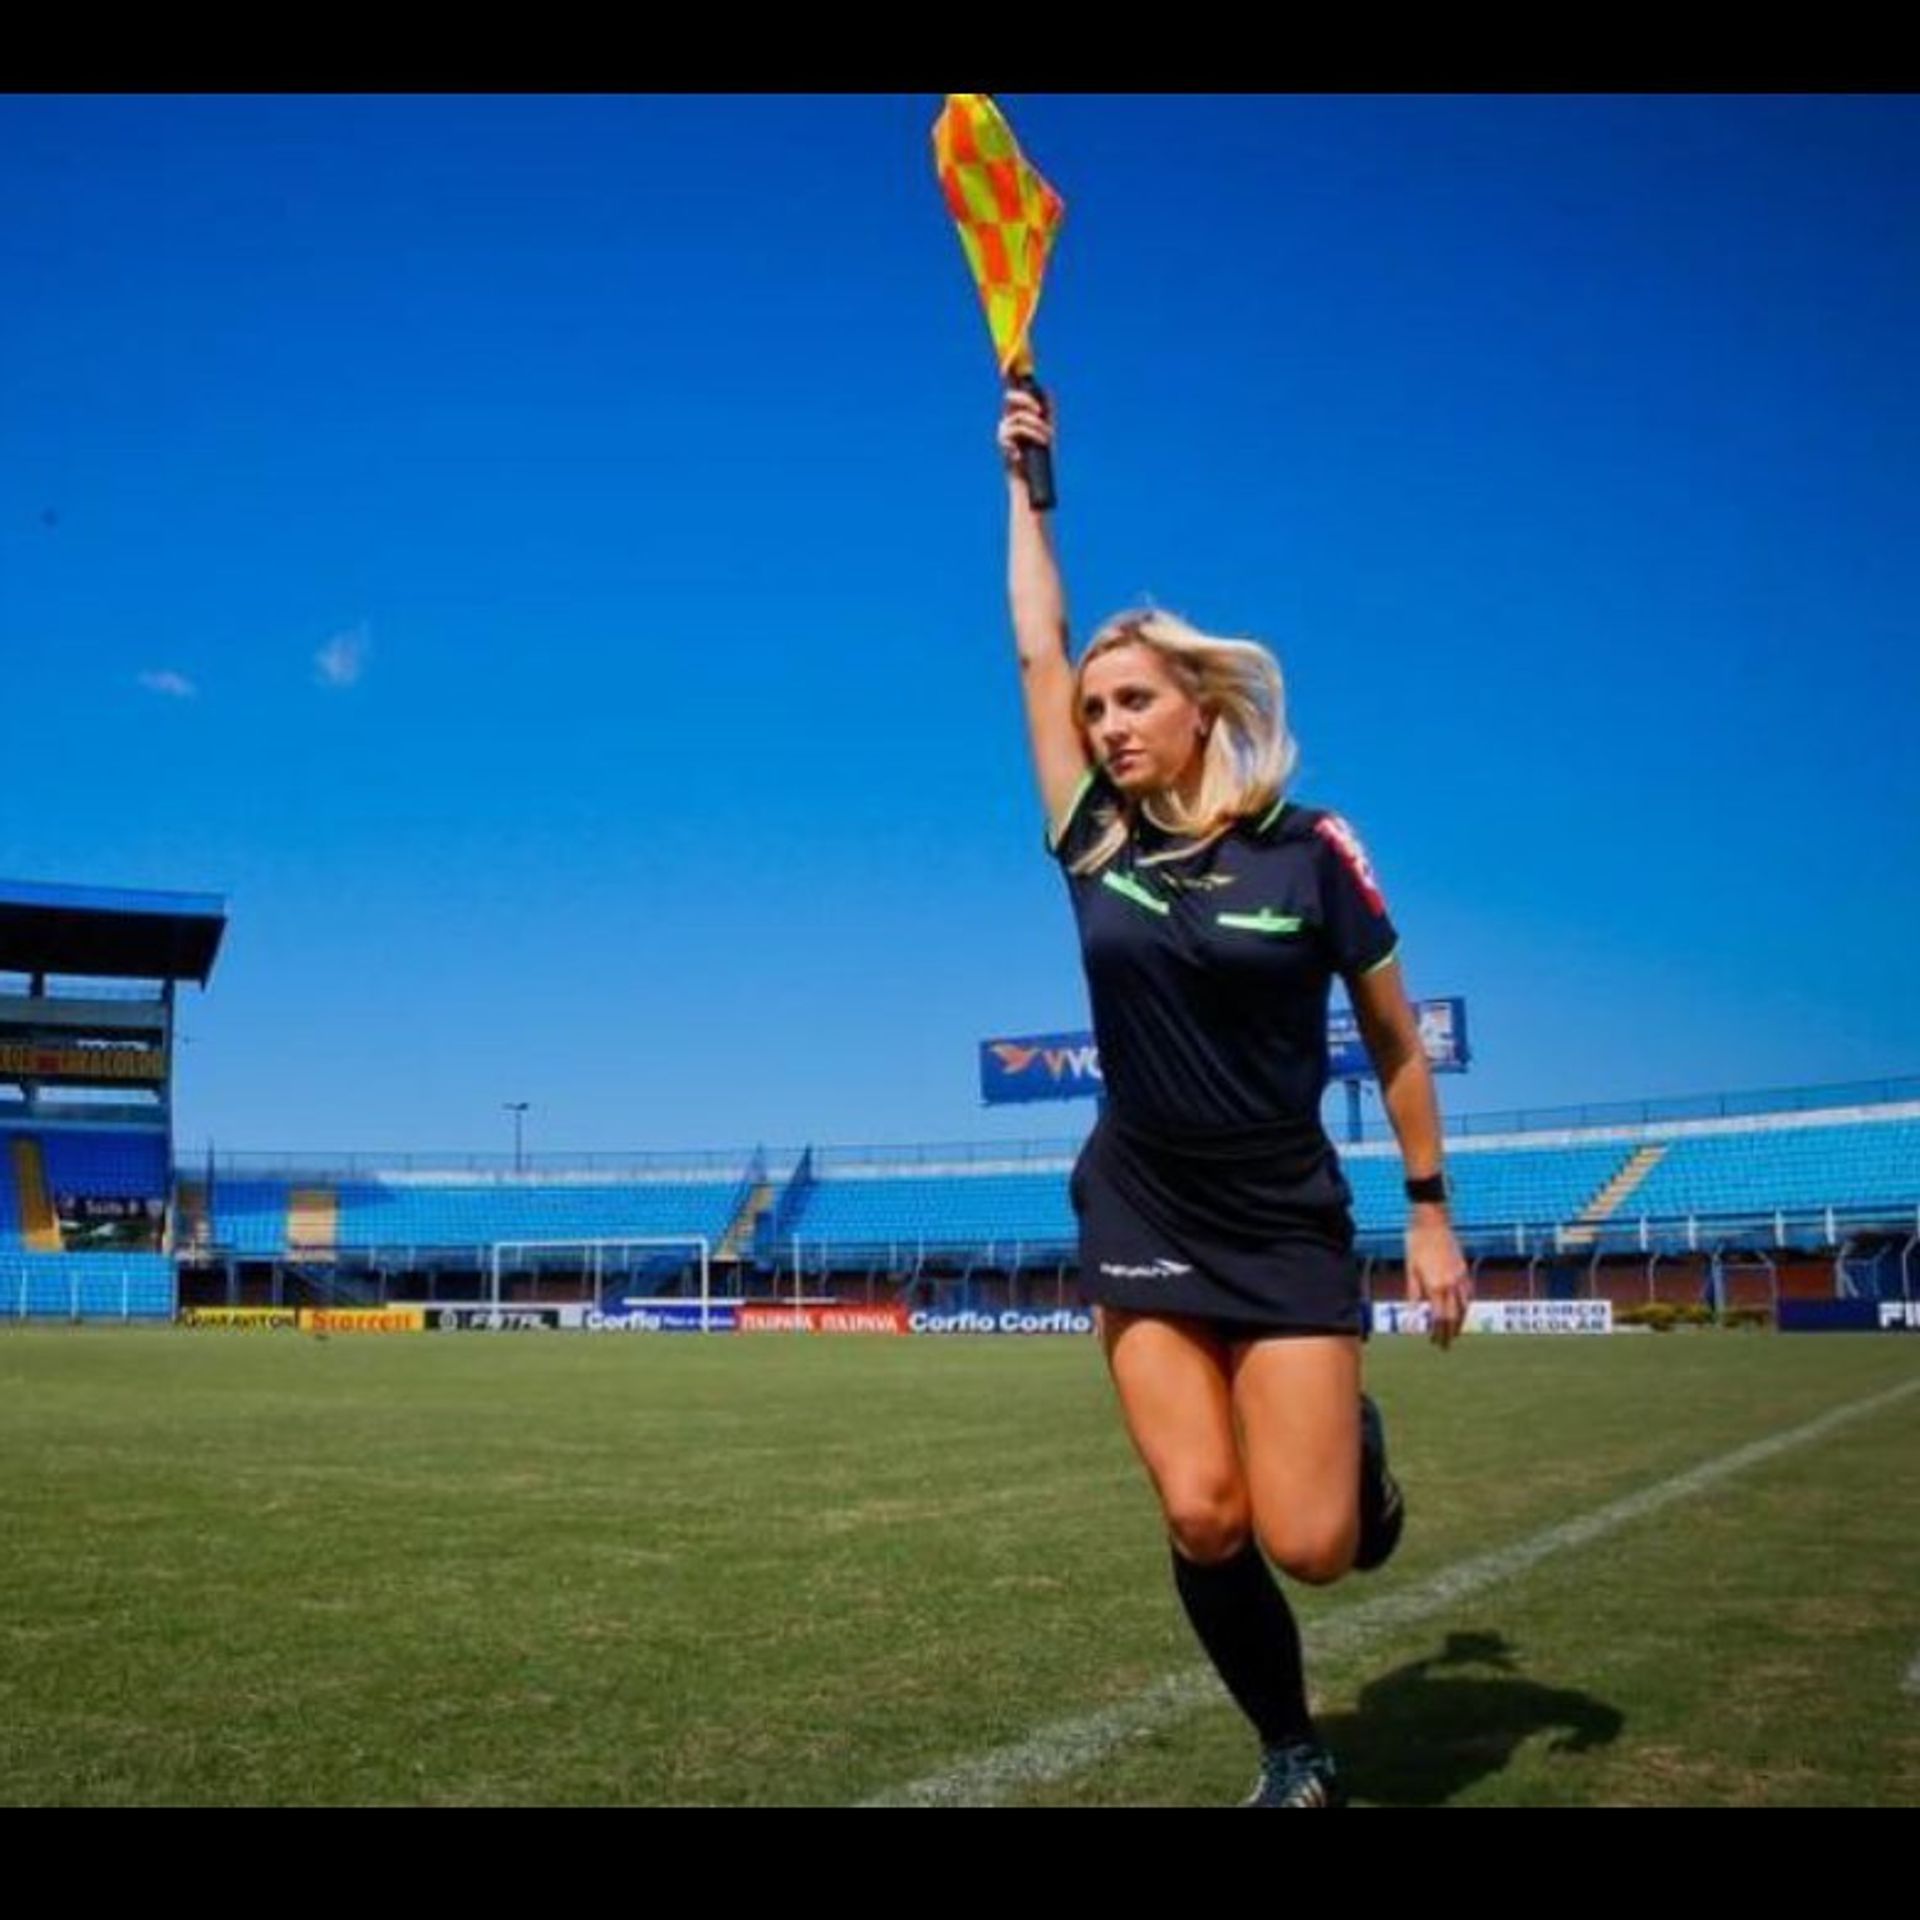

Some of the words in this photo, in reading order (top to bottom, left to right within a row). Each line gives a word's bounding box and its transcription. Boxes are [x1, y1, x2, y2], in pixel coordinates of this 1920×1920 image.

[311, 1308, 412, 1330] Starrett
[908, 1309, 996, 1331] Corfio
[1000, 1309, 1091, 1331] Corfio
